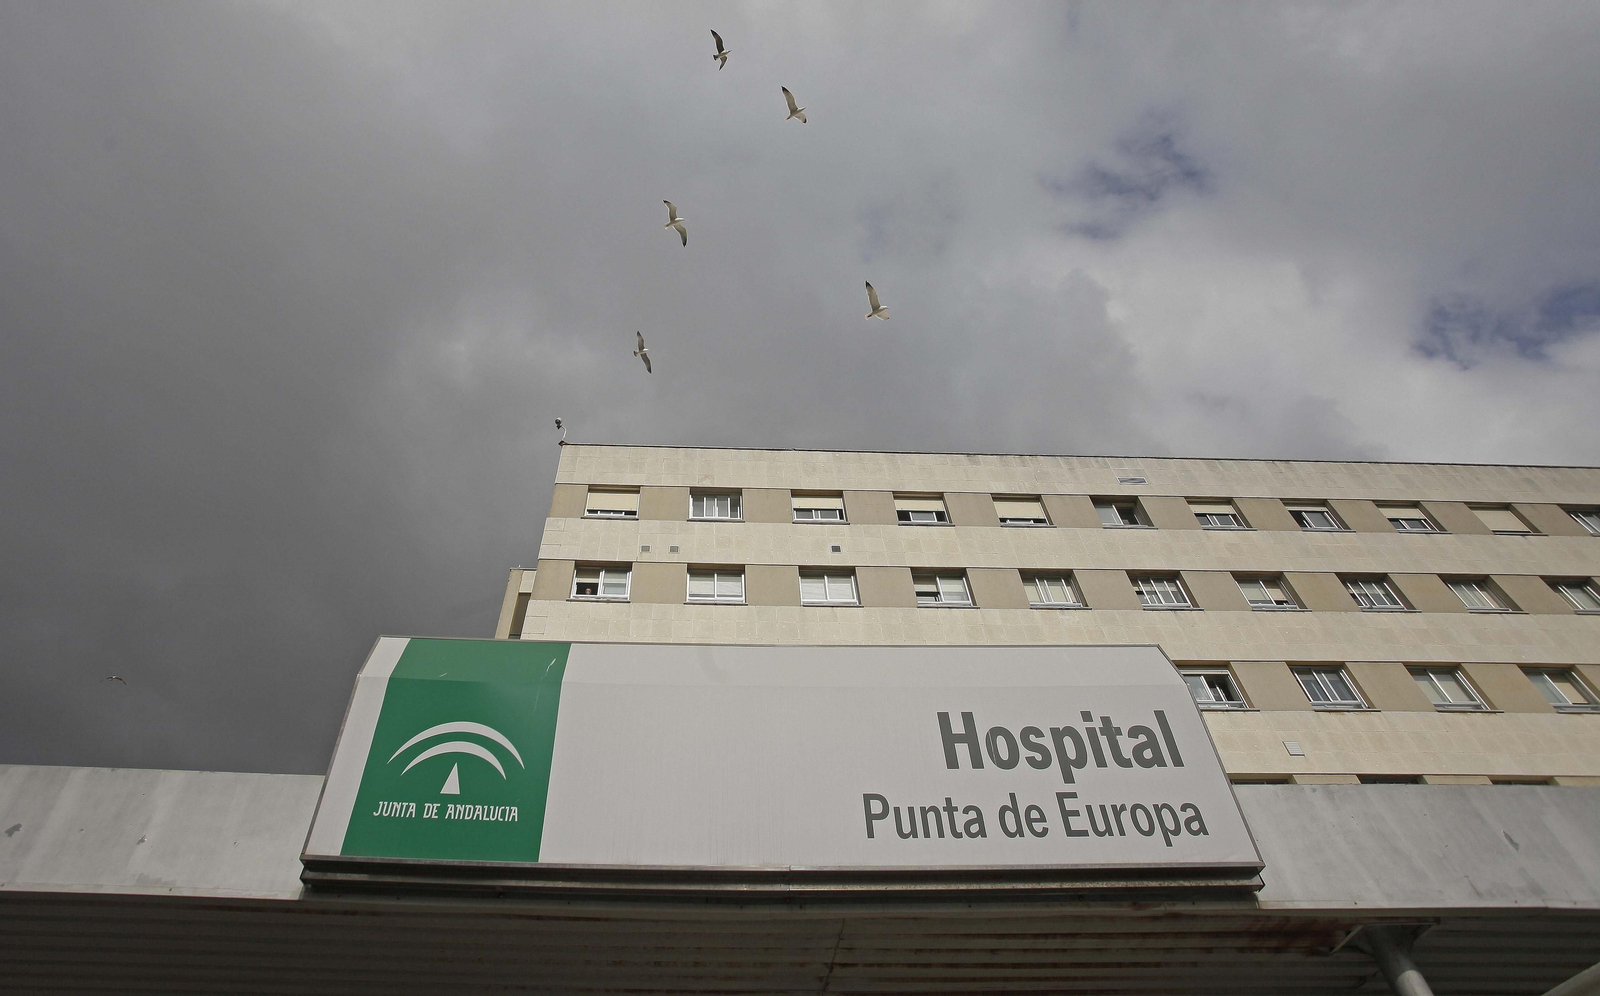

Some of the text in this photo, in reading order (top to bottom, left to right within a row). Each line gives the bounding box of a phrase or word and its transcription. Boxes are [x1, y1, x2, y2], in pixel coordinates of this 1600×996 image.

[936, 710, 1185, 784] Hospital
[373, 801, 518, 822] JUNTA DE ANDALUCIA
[862, 791, 1209, 848] Punta de Europa
